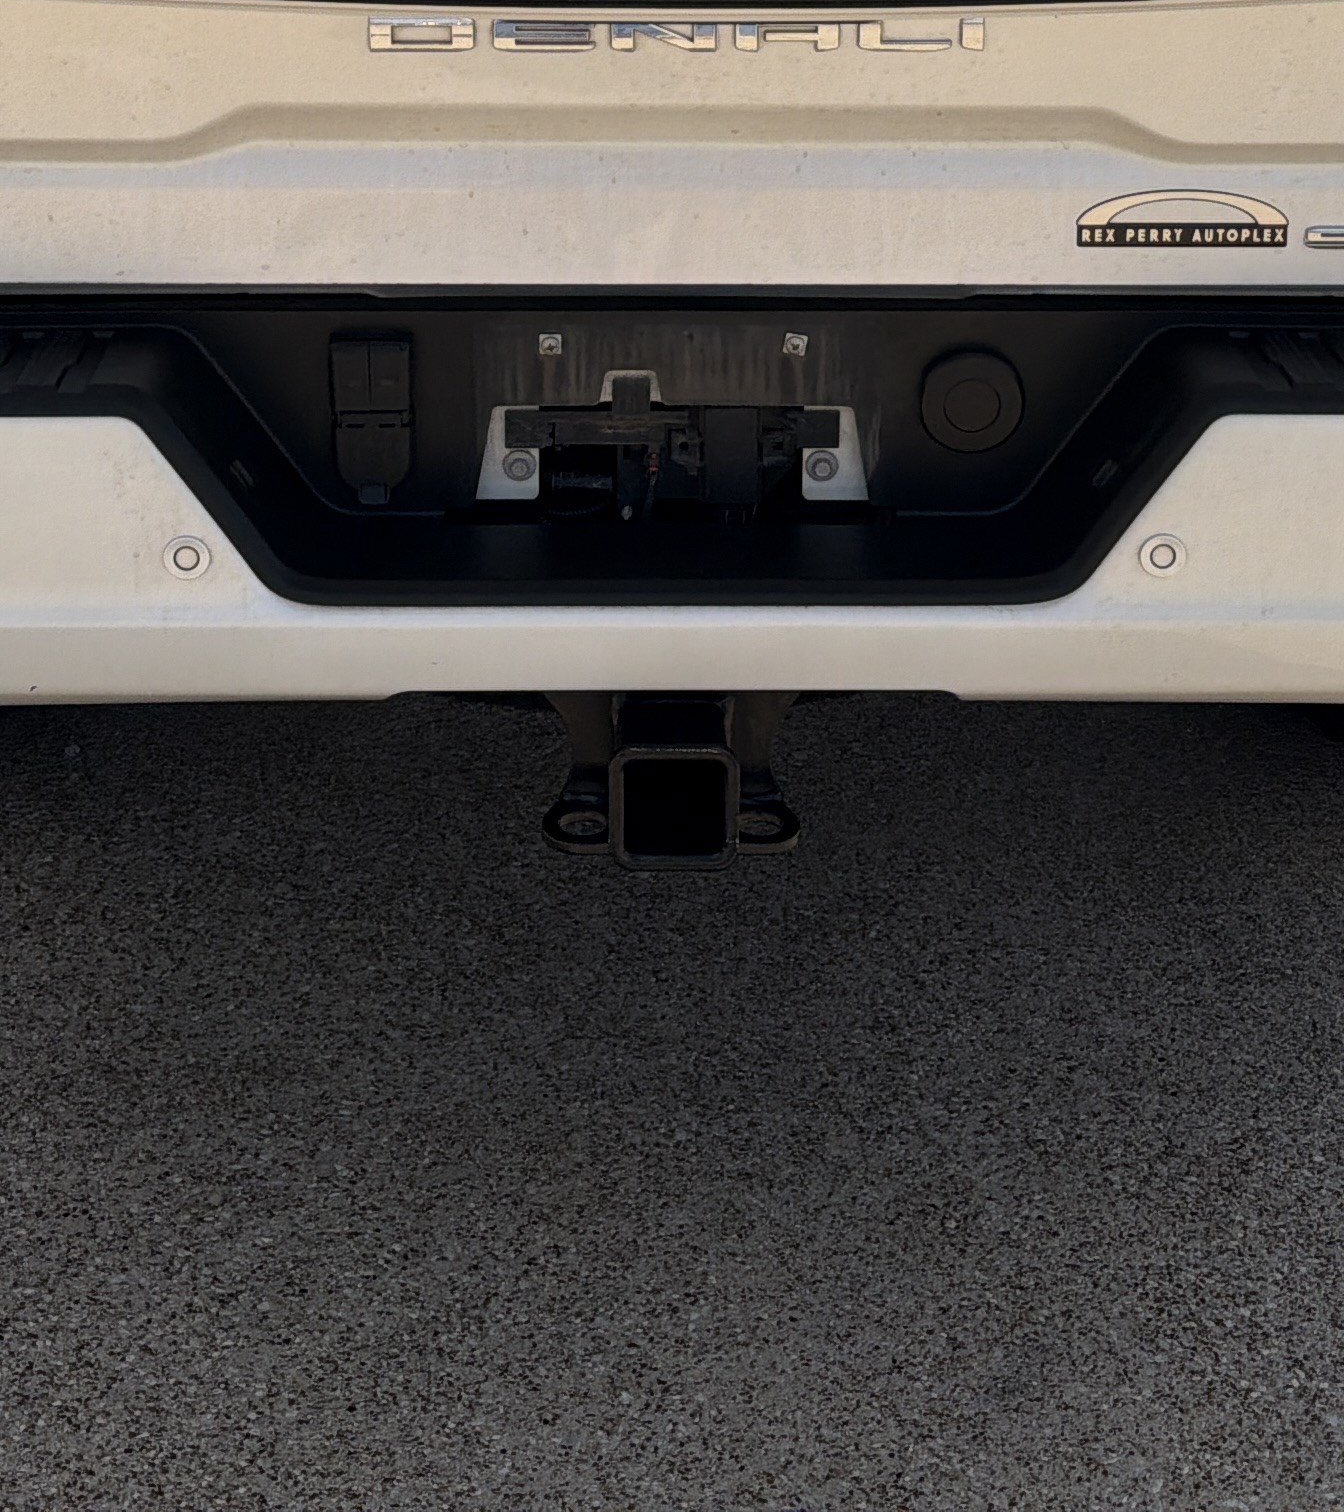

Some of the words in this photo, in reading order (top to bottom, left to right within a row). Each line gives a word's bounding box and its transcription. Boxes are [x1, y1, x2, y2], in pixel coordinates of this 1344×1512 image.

[367, 16, 985, 53] DENALI
[1081, 228, 1116, 243] REX
[1125, 228, 1183, 243] PERRY
[1191, 228, 1285, 243] AUTOPLEX
